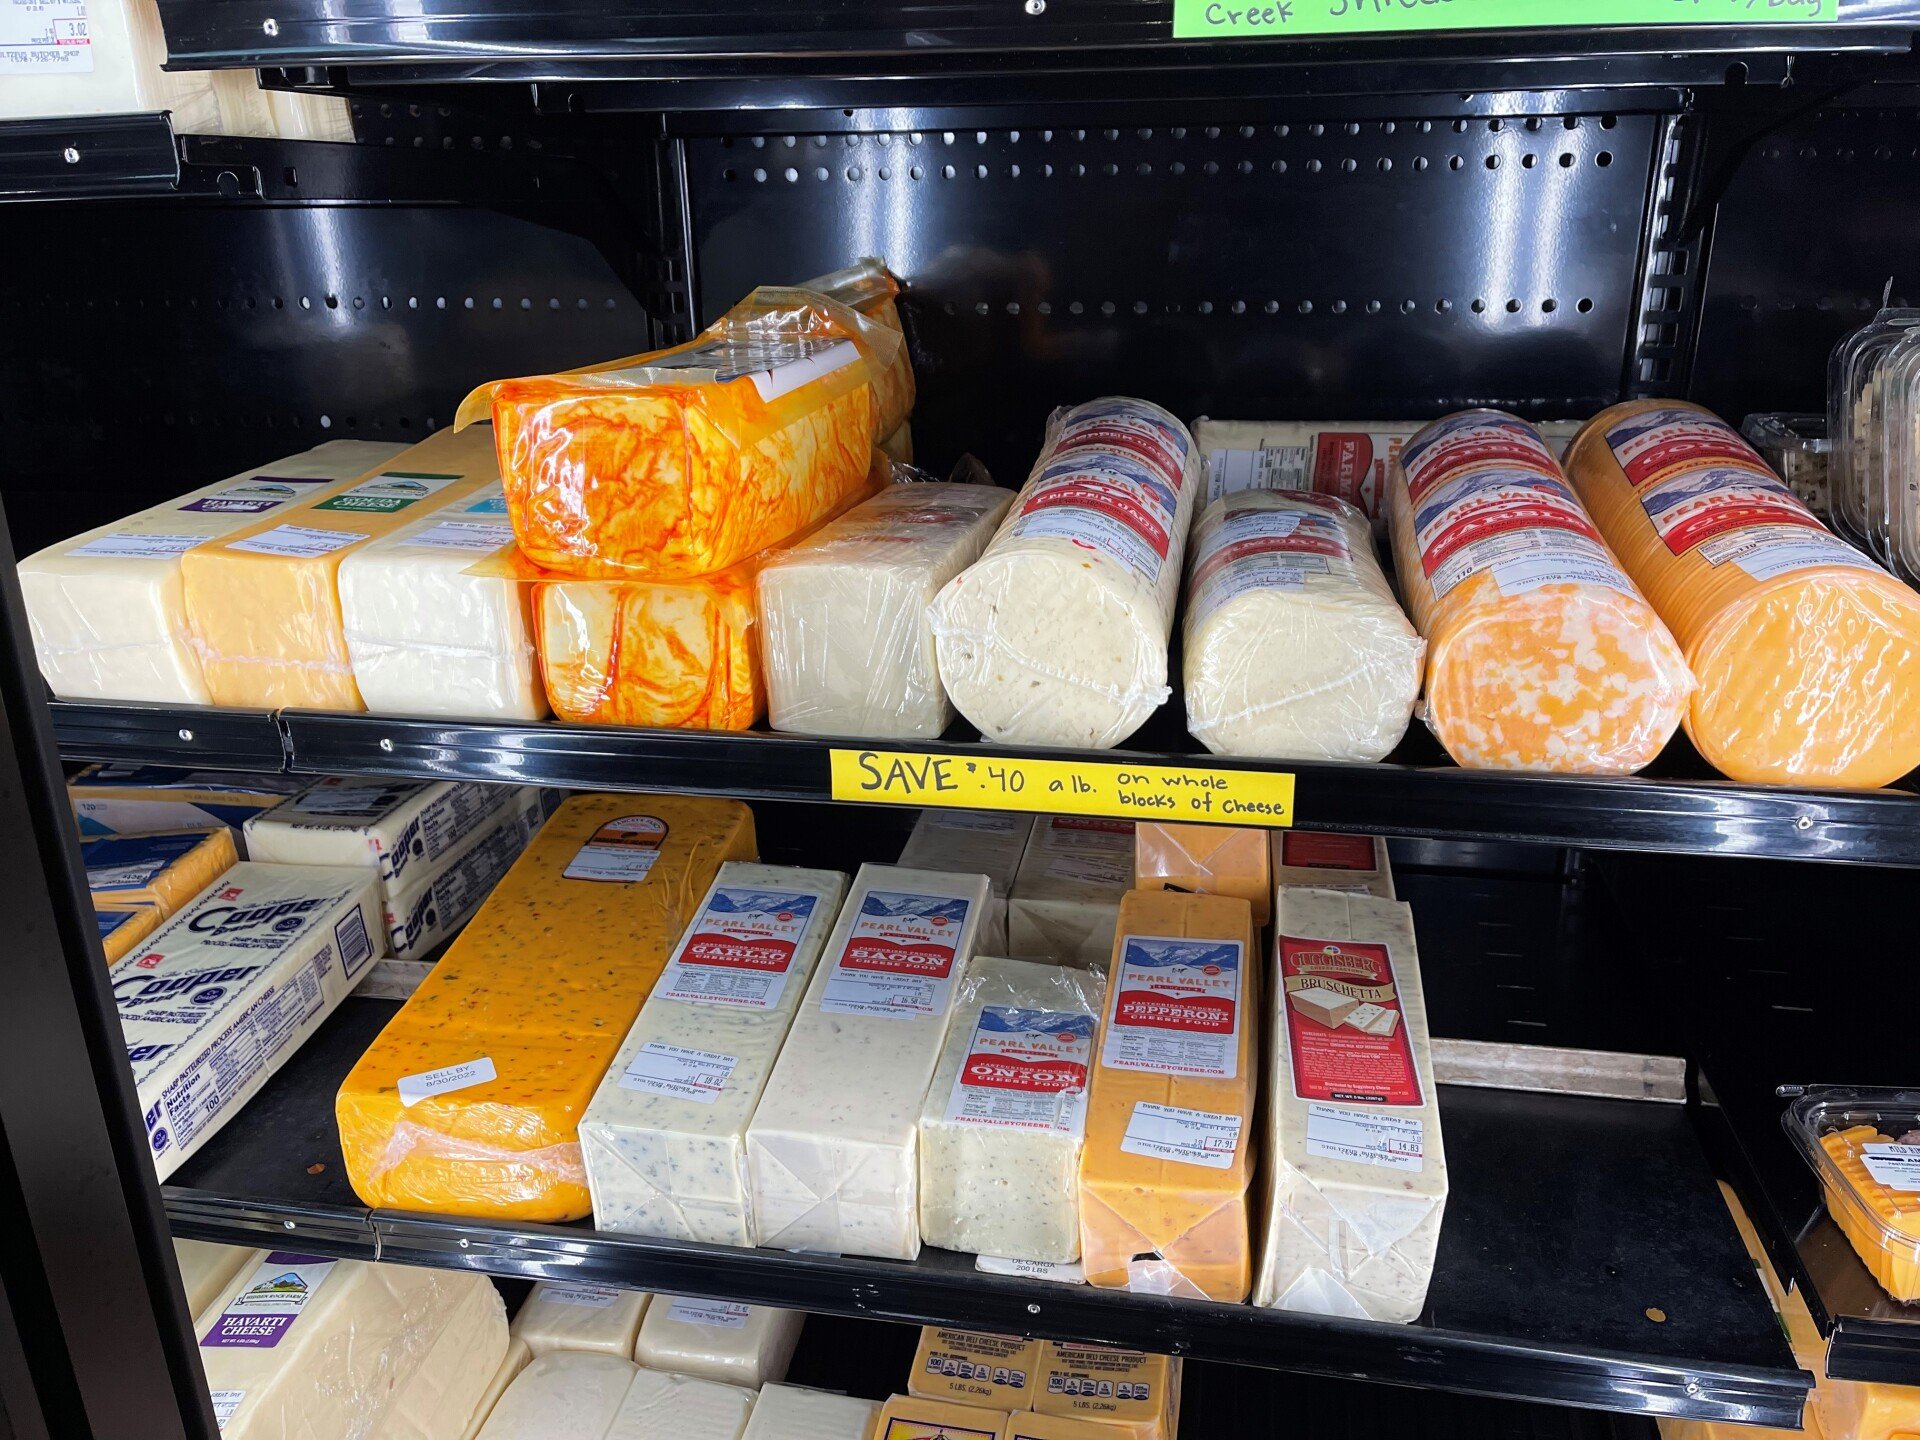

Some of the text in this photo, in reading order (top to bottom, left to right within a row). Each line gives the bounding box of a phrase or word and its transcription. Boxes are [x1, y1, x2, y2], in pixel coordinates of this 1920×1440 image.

[1205, 2, 1293, 25] Creek
[69, 23, 87, 36] 3.02
[1663, 494, 1740, 525] PEARL
[1424, 498, 1488, 541] PEARL
[859, 751, 958, 794] SAVE
[1072, 775, 1098, 794] lb.
[1117, 772, 1229, 791] on whole
[1118, 790, 1176, 810] blocks
[1191, 791, 1213, 813] of
[704, 918, 798, 933] PEARL VALLEY
[860, 921, 954, 937] PEARL VALLEY
[692, 945, 787, 961] GARLIC
[695, 954, 776, 966] CHEESE FOOD
[850, 950, 947, 966] BACON
[855, 958, 900, 967] CHEESE
[1290, 952, 1382, 973] GUGGISBERG
[113, 966, 262, 1002] Cooper
[1128, 973, 1230, 988] PEARL VALLEY
[1301, 978, 1382, 999] BRUSCHETTA
[1123, 1004, 1229, 1021] PEPPERONI
[1131, 1001, 1184, 1009] PASTEURIZED
[1130, 1015, 1219, 1027] CHEESE FOOD
[162, 1078, 180, 1100] SHARP
[211, 1025, 234, 1052] PROCESS
[232, 1002, 259, 1031] AMERICAN
[256, 985, 276, 1008] CHEESE
[979, 1038, 1083, 1054] PEARL VALLEY
[425, 1065, 470, 1081] SELL BY
[970, 1066, 1080, 1083] ONION
[1112, 1059, 1226, 1075] PEARLVALLEYCHEESE.COM
[426, 1070, 476, 1087] 8/30/2022
[977, 1075, 1028, 1085] CHEESE
[166, 1073, 201, 1108] Nutrition
[168, 1093, 191, 1116] Facts
[205, 1095, 220, 1113] 100
[954, 1116, 1070, 1132] PEARLVALLEYCHEESE.OM
[1213, 1139, 1233, 1149] 17.91
[1025, 1260, 1056, 1268] CARGA
[222, 1317, 288, 1327] HAVARTI
[221, 1326, 276, 1336] CHEESE
[937, 1332, 965, 1341] AMERICAN
[966, 1335, 978, 1343] DELI
[979, 1337, 999, 1347] CHEESE
[1001, 1340, 1026, 1351] PRODUCT
[1057, 1351, 1084, 1359] AMERICAN
[1099, 1354, 1120, 1362] CHEESE
[1122, 1356, 1147, 1364] PRODUCT
[955, 1384, 966, 1392] LBS.
